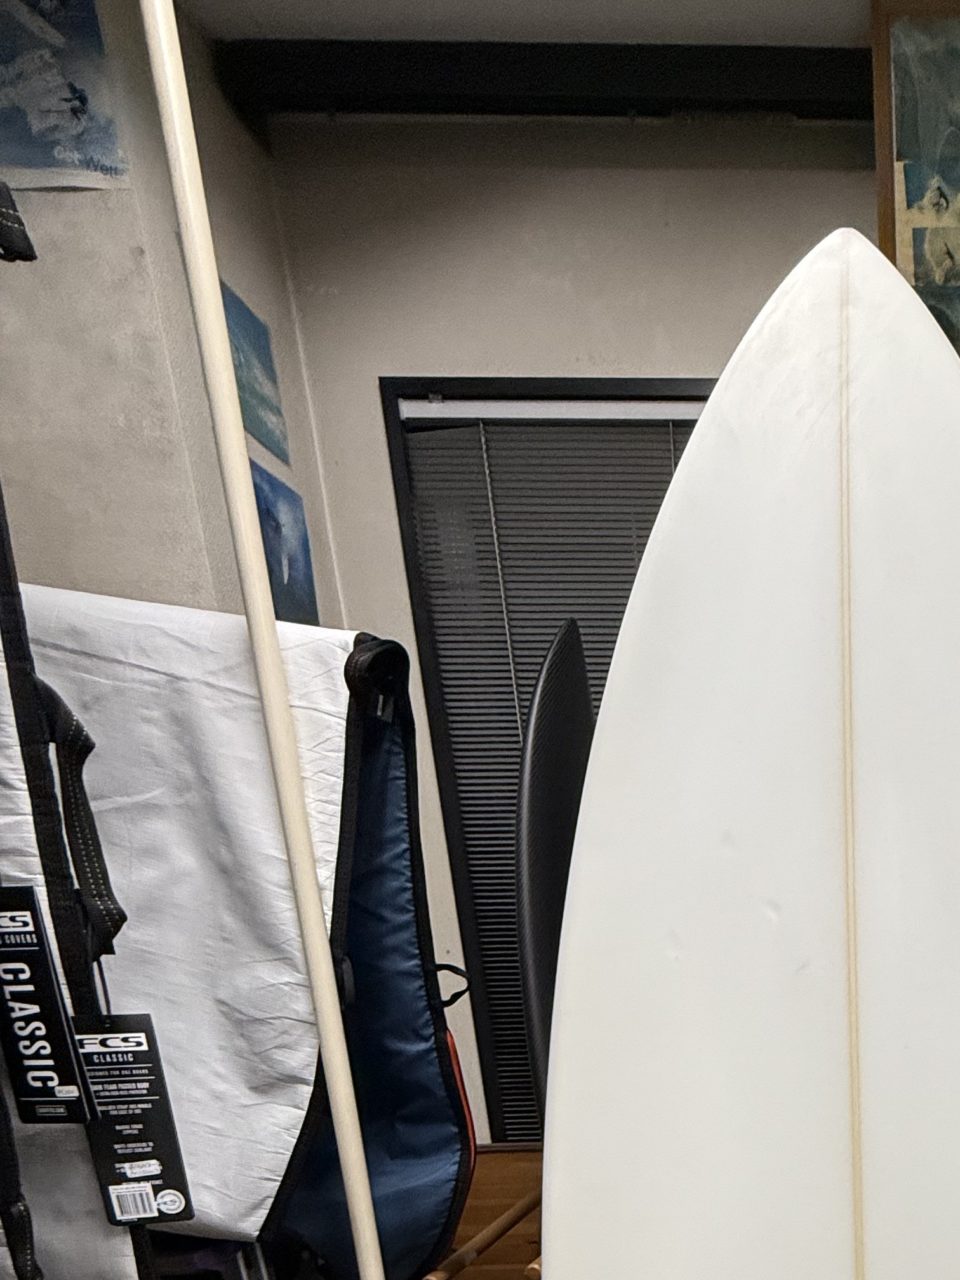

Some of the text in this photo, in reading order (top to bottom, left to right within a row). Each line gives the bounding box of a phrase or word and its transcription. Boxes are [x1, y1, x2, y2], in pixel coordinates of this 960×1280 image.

[0, 962, 59, 1088] CLASSIC
[77, 1035, 144, 1050] FCS
[93, 1053, 134, 1063] CLASSIC
